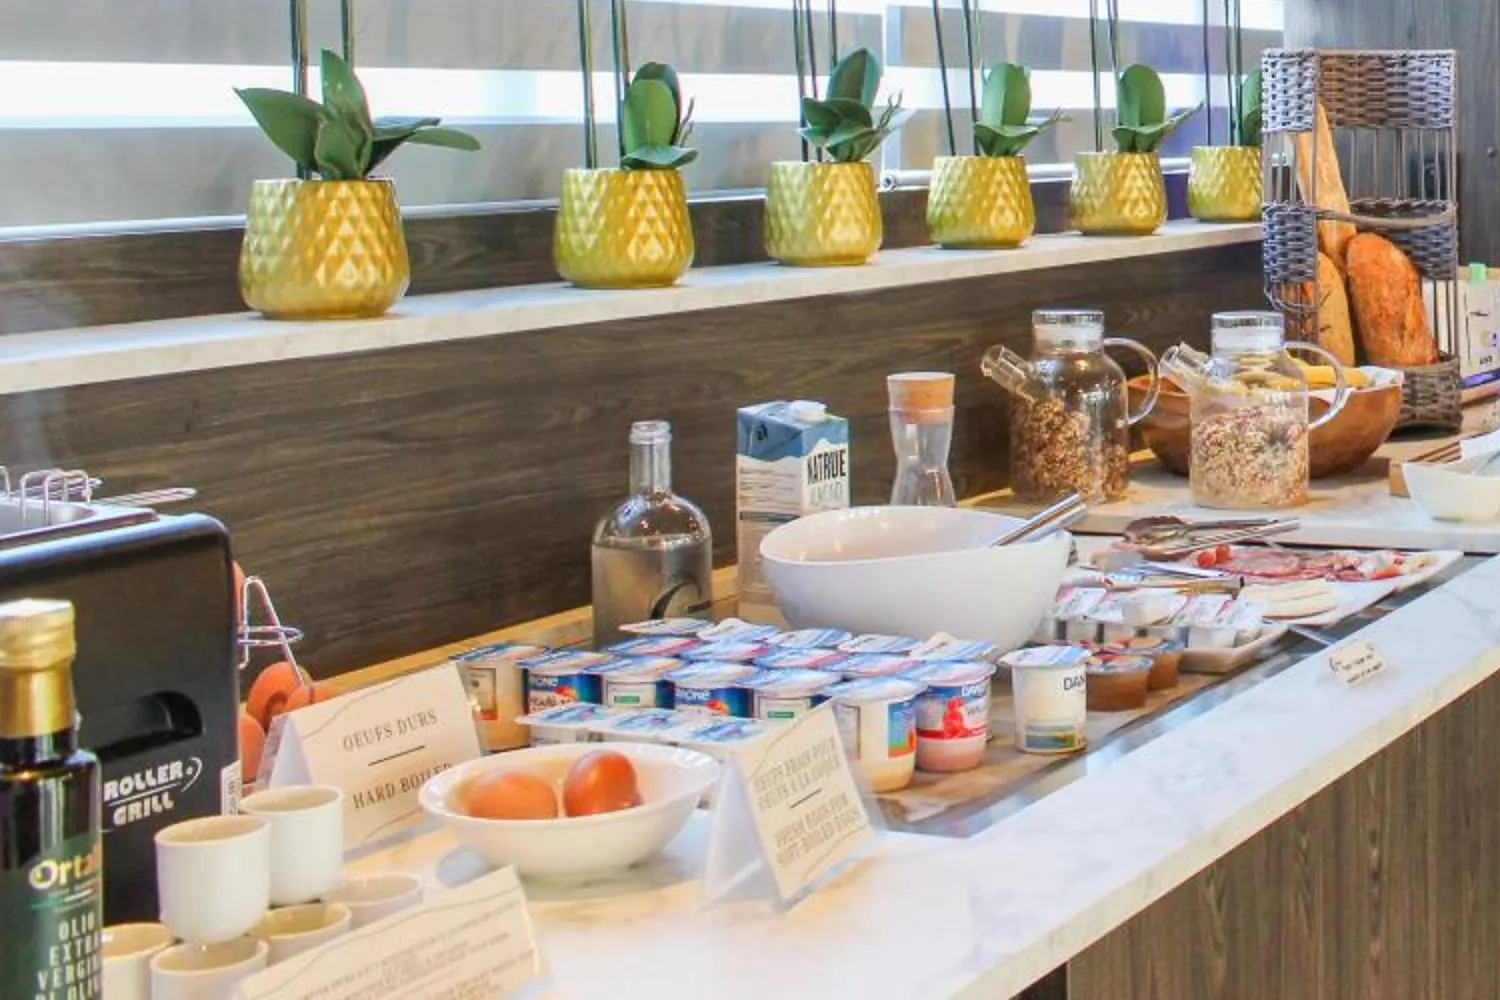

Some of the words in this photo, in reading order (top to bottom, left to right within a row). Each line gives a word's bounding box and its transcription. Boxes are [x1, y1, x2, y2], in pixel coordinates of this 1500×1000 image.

[104, 760, 183, 802] ROLLER
[352, 783, 396, 809] HARD
[113, 792, 174, 826] GRILL
[59, 911, 95, 940] OLIO
